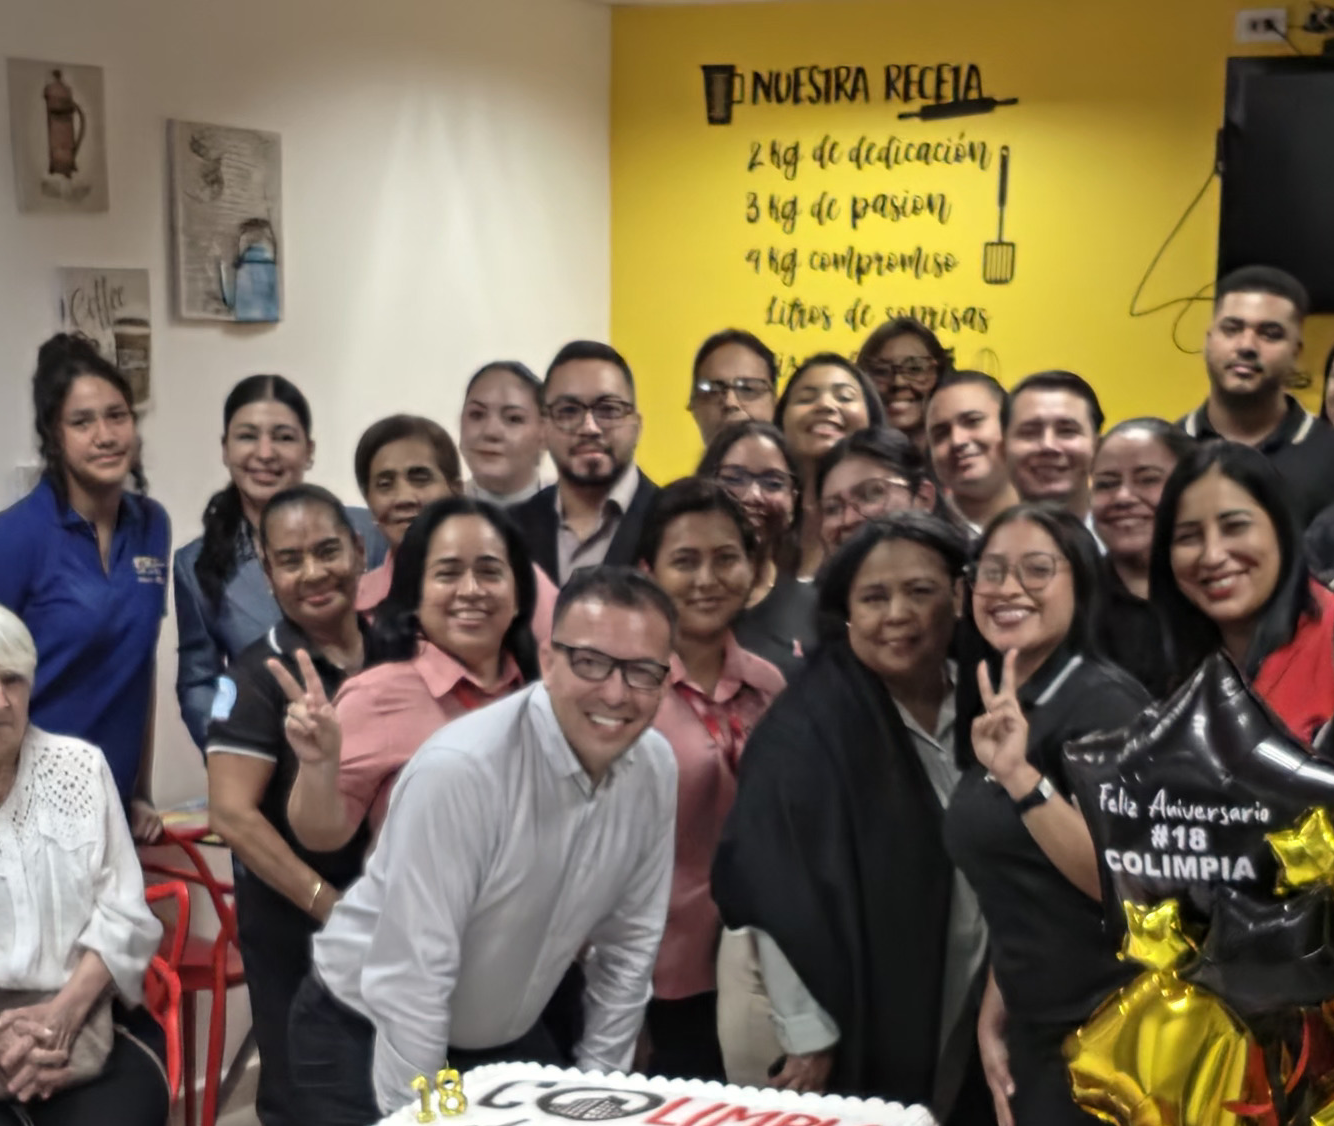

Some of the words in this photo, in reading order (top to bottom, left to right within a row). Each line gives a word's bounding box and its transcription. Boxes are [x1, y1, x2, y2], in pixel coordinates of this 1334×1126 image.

[752, 65, 870, 105] NUESTRA
[884, 64, 983, 104] RECETA
[747, 141, 765, 172] 2
[770, 138, 801, 181] kg
[812, 134, 842, 170] de
[848, 131, 992, 171] dedicación
[746, 191, 760, 223] 3
[768, 194, 801, 234] kg
[811, 191, 842, 226] de
[768, 247, 801, 287] kg
[809, 245, 959, 286] compromiso
[844, 297, 875, 332] de
[1098, 783, 1138, 819] Feliz
[1148, 788, 1271, 825] Aniversario
[1150, 824, 1208, 851] #18
[1104, 848, 1256, 881] COLIMPIA
